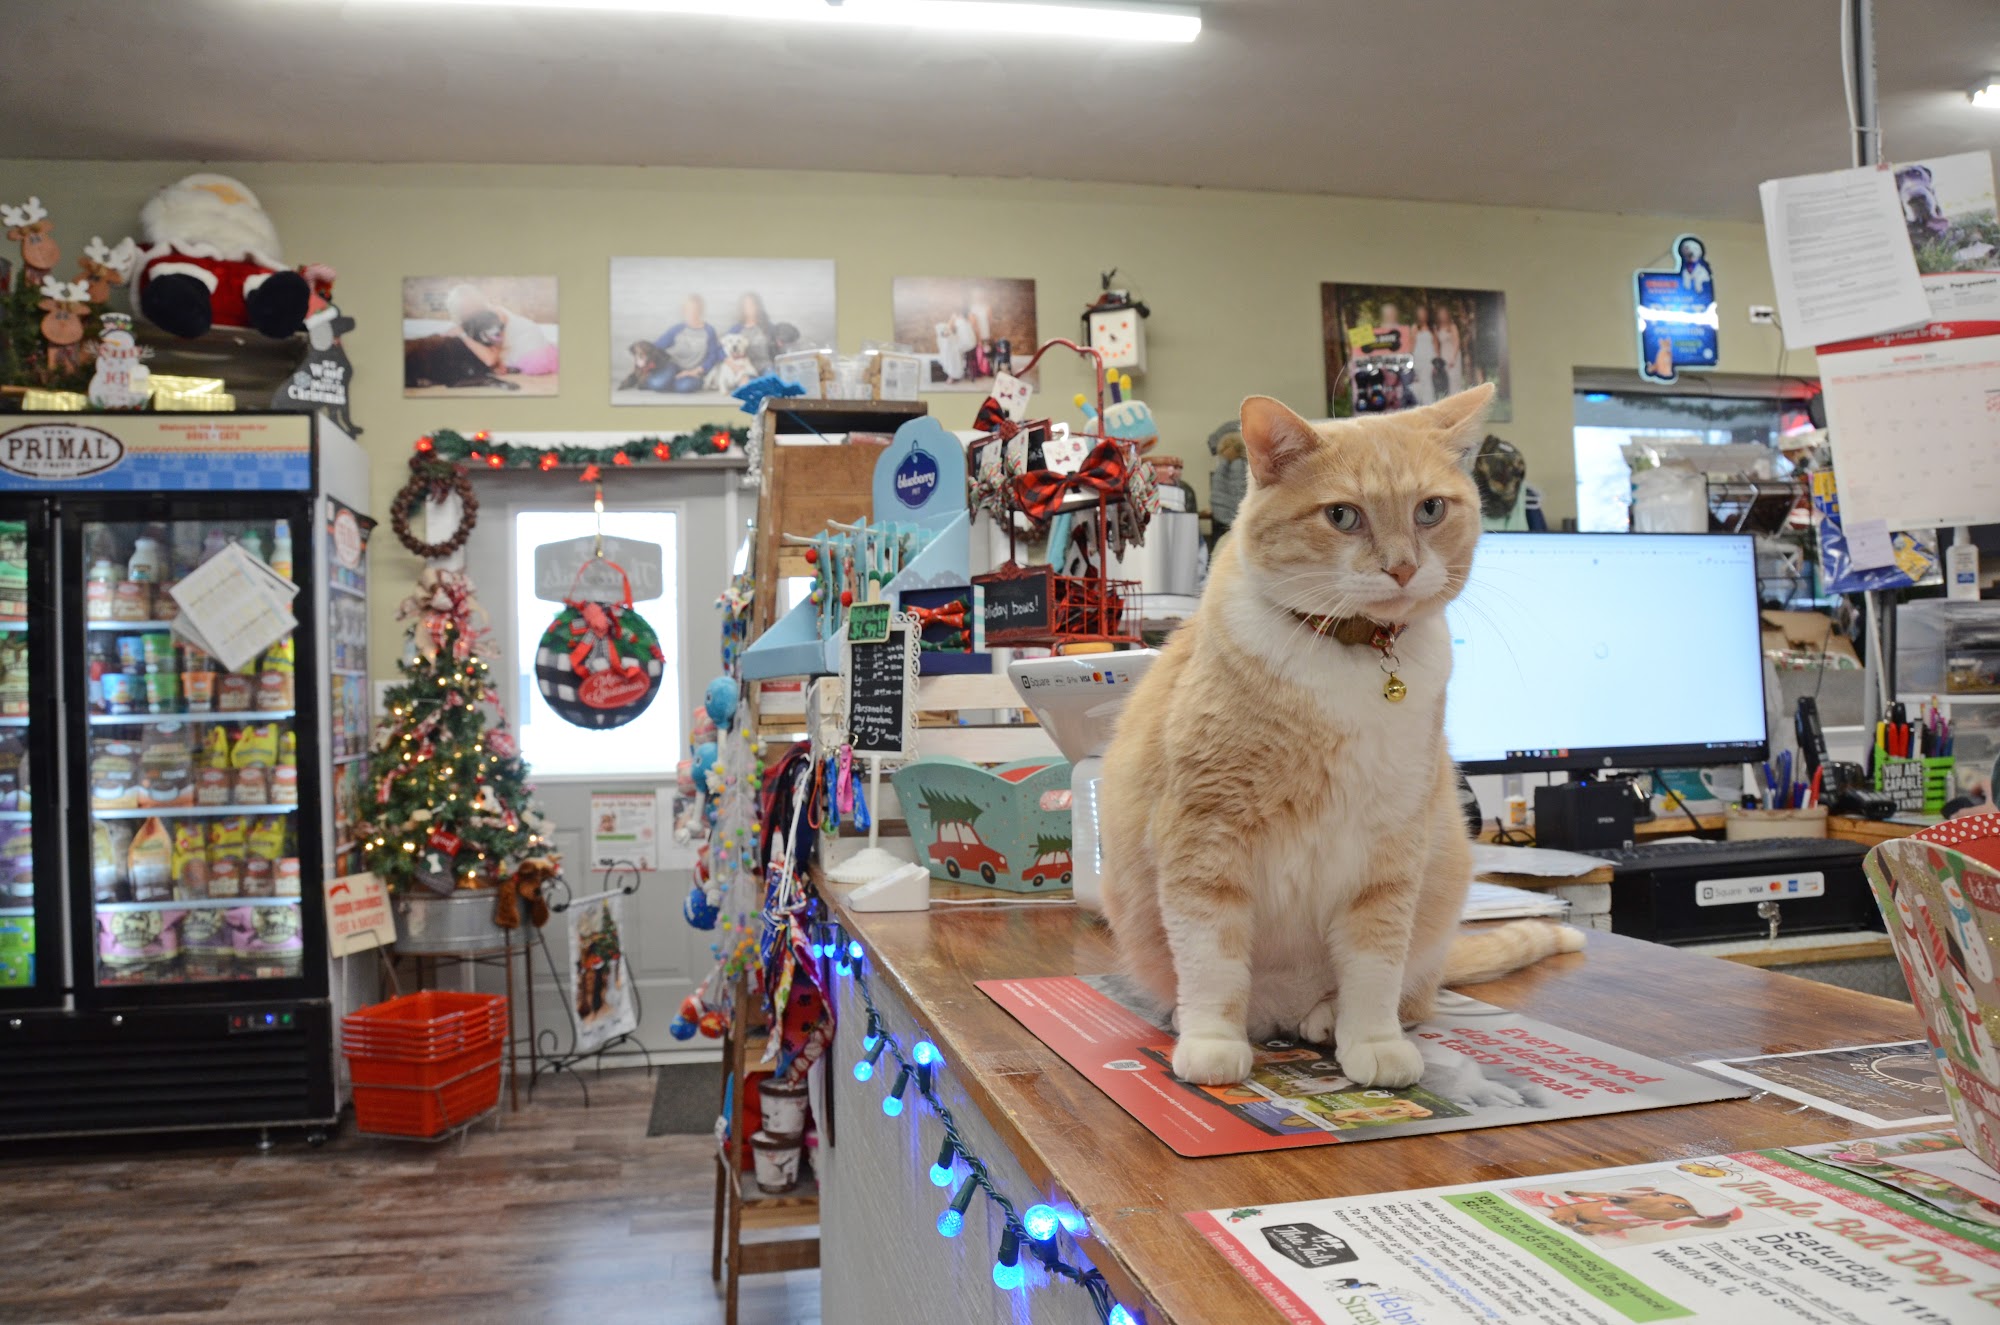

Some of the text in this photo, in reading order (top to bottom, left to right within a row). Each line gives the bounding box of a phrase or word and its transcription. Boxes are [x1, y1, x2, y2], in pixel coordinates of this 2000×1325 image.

[8, 437, 110, 460] PRIMAL
[897, 470, 935, 489] blueberry
[1011, 595, 1039, 615] bows!
[1030, 678, 1051, 688] Square
[1884, 761, 1921, 779] YOU ARE
[1884, 776, 1922, 792] CAPABLE
[1715, 886, 1763, 897] Square VISA
[1418, 1032, 1593, 1100] a tasty treat.
[1450, 1027, 1636, 1095] dog deserves
[1495, 1028, 1666, 1085] Every good
[1840, 1169, 1887, 1194] family
[1914, 1203, 1955, 1223] dogs
[1273, 1226, 1337, 1266] Three Tails
[1356, 1215, 1397, 1242] Pre-register
[1384, 1205, 1403, 1216] Best
[1398, 1217, 1422, 1231] Jingle
[1419, 1231, 1439, 1240] Bell
[1459, 1258, 1482, 1270] Best
[1477, 1269, 1510, 1290] Holiday
[1400, 1203, 1560, 1311] Costume Contest for dogs and owners: Best
[1419, 1201, 1439, 1213] Walk
[1435, 1213, 1455, 1224] bags
[1452, 1225, 1487, 1244] available
[1509, 1259, 1525, 1268] tee
[1522, 1269, 1550, 1286] shirts
[1548, 1287, 1568, 1298] will
[1564, 1299, 1579, 1307] be
[1462, 1201, 1480, 1209] $25
[1486, 1214, 1504, 1223] the
[1500, 1225, 1521, 1235] door
[1533, 1242, 1552, 1250] for
[1547, 1252, 1602, 1283] additional
[1596, 1284, 1620, 1297] dog
[1475, 1196, 1496, 1205] $20
[1490, 1206, 1514, 1216] each
[1520, 1224, 1544, 1234] walk
[1541, 1235, 1565, 1246] with
[1561, 1248, 1583, 1258] one
[1580, 1260, 1604, 1271] dog
[1615, 1282, 1670, 1311] advance)
[1719, 1180, 1974, 1286] Jingle Bell Dog
[1731, 1238, 1794, 1271] 2:00 pm
[1333, 1210, 1350, 1222] form
[1354, 1227, 1376, 1239] either
[1373, 1240, 1395, 1254] Three
[1392, 1254, 1411, 1265] Tails
[1408, 1266, 1435, 1282] Parlor
[1430, 1284, 1452, 1294] and
[1446, 1295, 1476, 1314] Pantry
[1368, 1206, 1395, 1224] Holiday
[1423, 1247, 1442, 1258] Plus
[1439, 1258, 1462, 1271] many
[1460, 1272, 1483, 1286] more
[1480, 1287, 1526, 1316] activities!
[1652, 1249, 1740, 1296] Waterloo, IL
[1678, 1246, 1830, 1325] 401 West 3rd Street
[1706, 1242, 1841, 1311] Three Tails Parlor and
[1756, 1234, 1886, 1292] December
[1775, 1231, 1899, 1286] Saturday,
